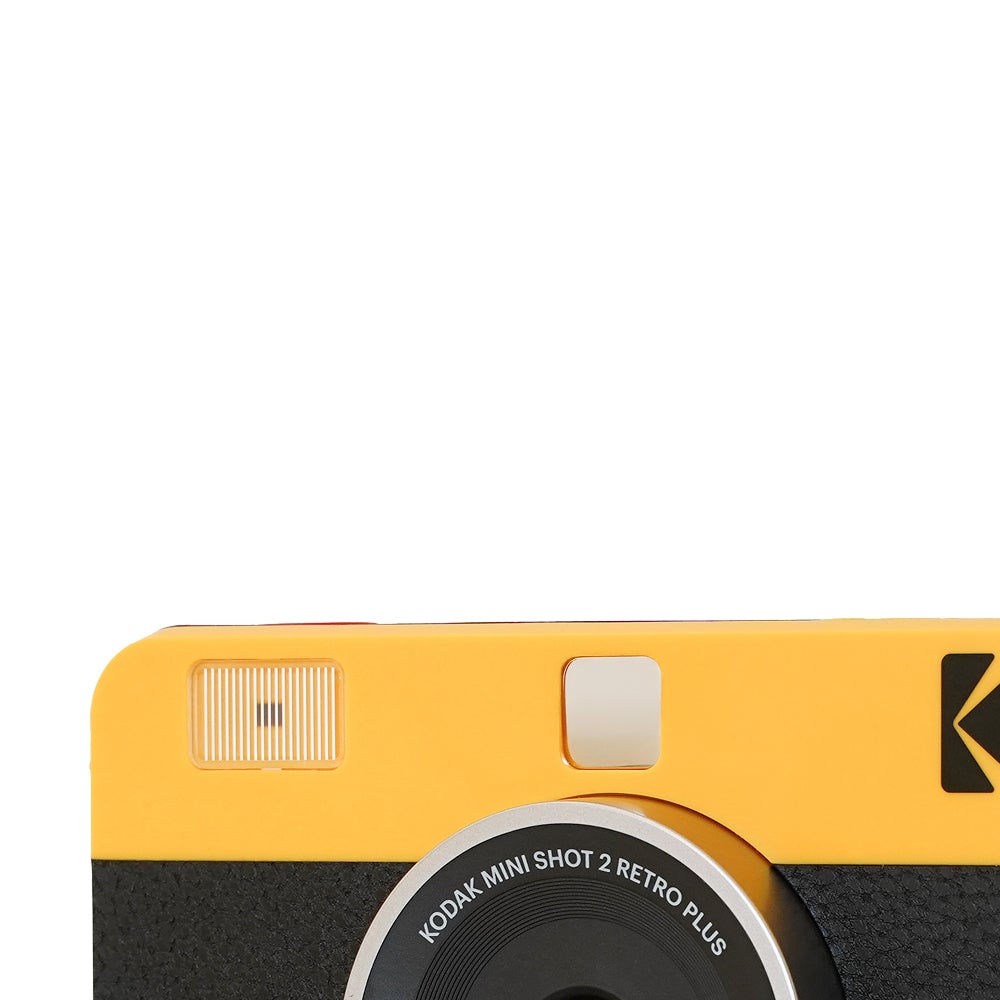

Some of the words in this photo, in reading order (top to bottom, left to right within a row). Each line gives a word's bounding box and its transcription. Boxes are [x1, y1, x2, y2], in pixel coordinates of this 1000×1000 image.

[418, 876, 484, 944] KODAK
[480, 854, 531, 889] MINI
[533, 848, 594, 870] SHOT
[598, 853, 612, 873] 2
[616, 857, 683, 907] RETRO
[682, 900, 727, 956] PLUS
